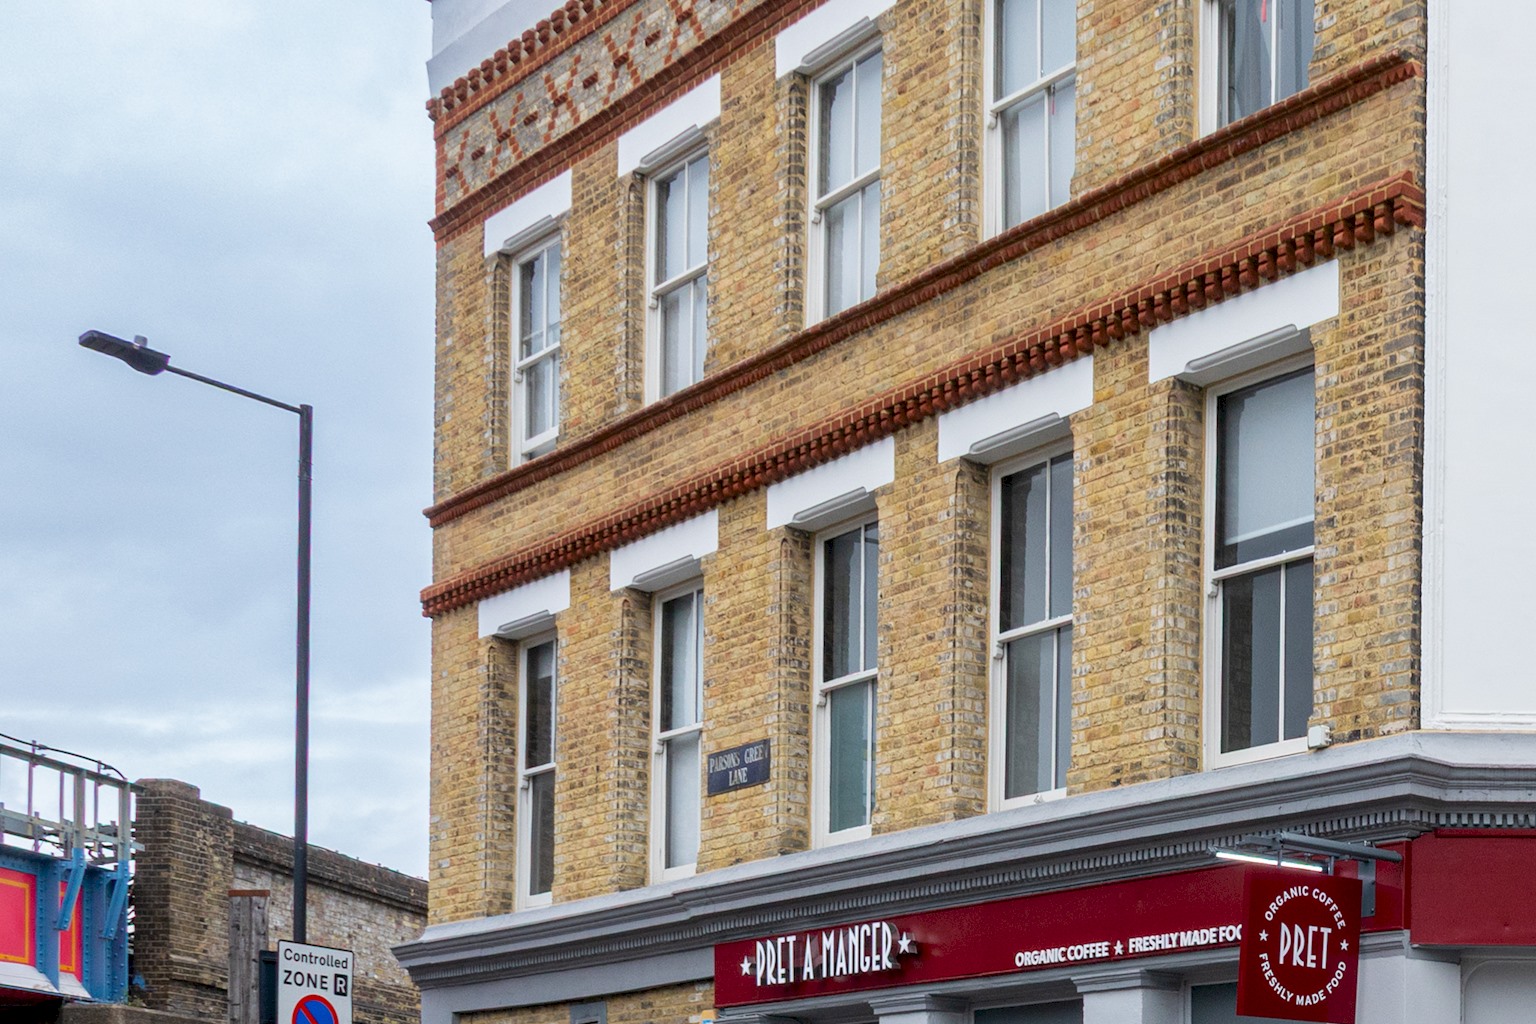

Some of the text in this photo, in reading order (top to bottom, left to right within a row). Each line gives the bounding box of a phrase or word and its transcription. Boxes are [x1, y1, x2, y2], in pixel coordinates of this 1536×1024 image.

[729, 767, 748, 786] LANE
[1264, 885, 1346, 930] ORGANIC COFFEE
[284, 948, 348, 970] Controlled
[756, 921, 893, 986] PRET A MANGER
[1014, 924, 1242, 968] ORGANIC COFFEE FRESHLY MADE FOO
[1279, 921, 1332, 970] PRET
[284, 970, 347, 995] ZONE R
[1259, 952, 1346, 1006] FRESHLY MADE FOOD
